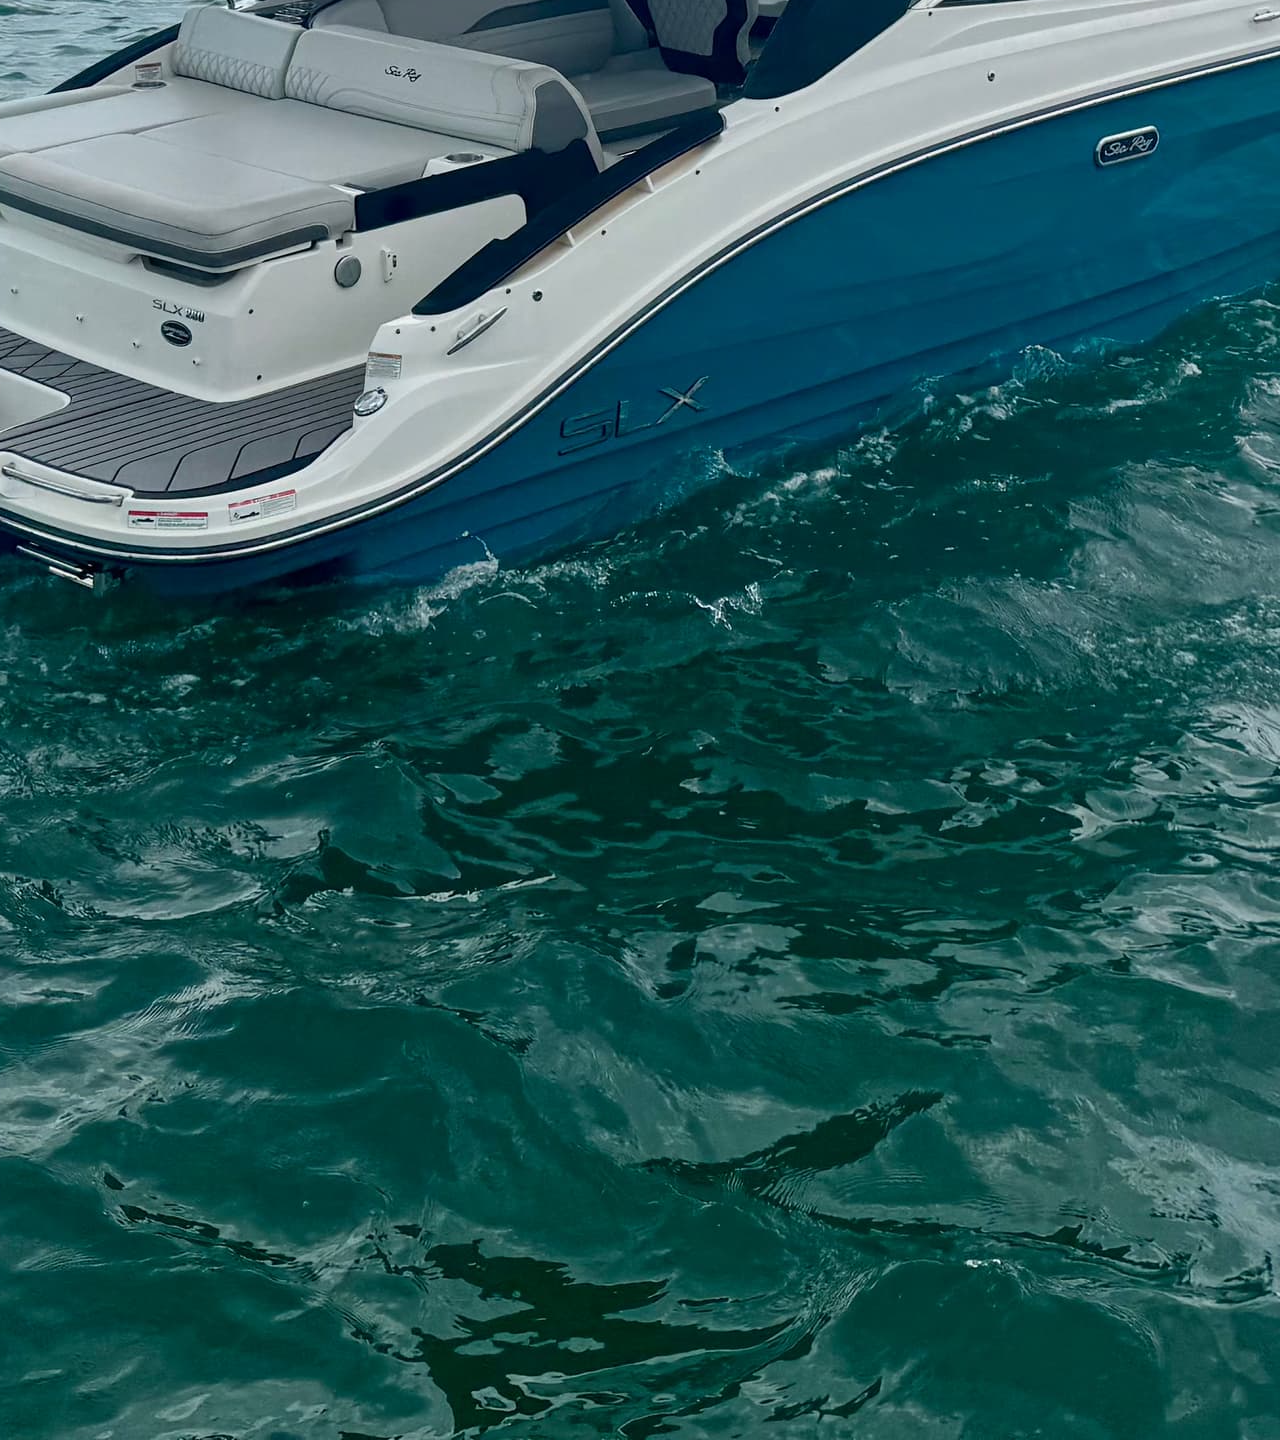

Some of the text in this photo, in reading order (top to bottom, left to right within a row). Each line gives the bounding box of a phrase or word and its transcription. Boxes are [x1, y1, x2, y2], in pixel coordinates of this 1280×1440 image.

[1104, 142, 1128, 157] Sea
[152, 299, 183, 317] SLX
[558, 375, 709, 456] SLX
